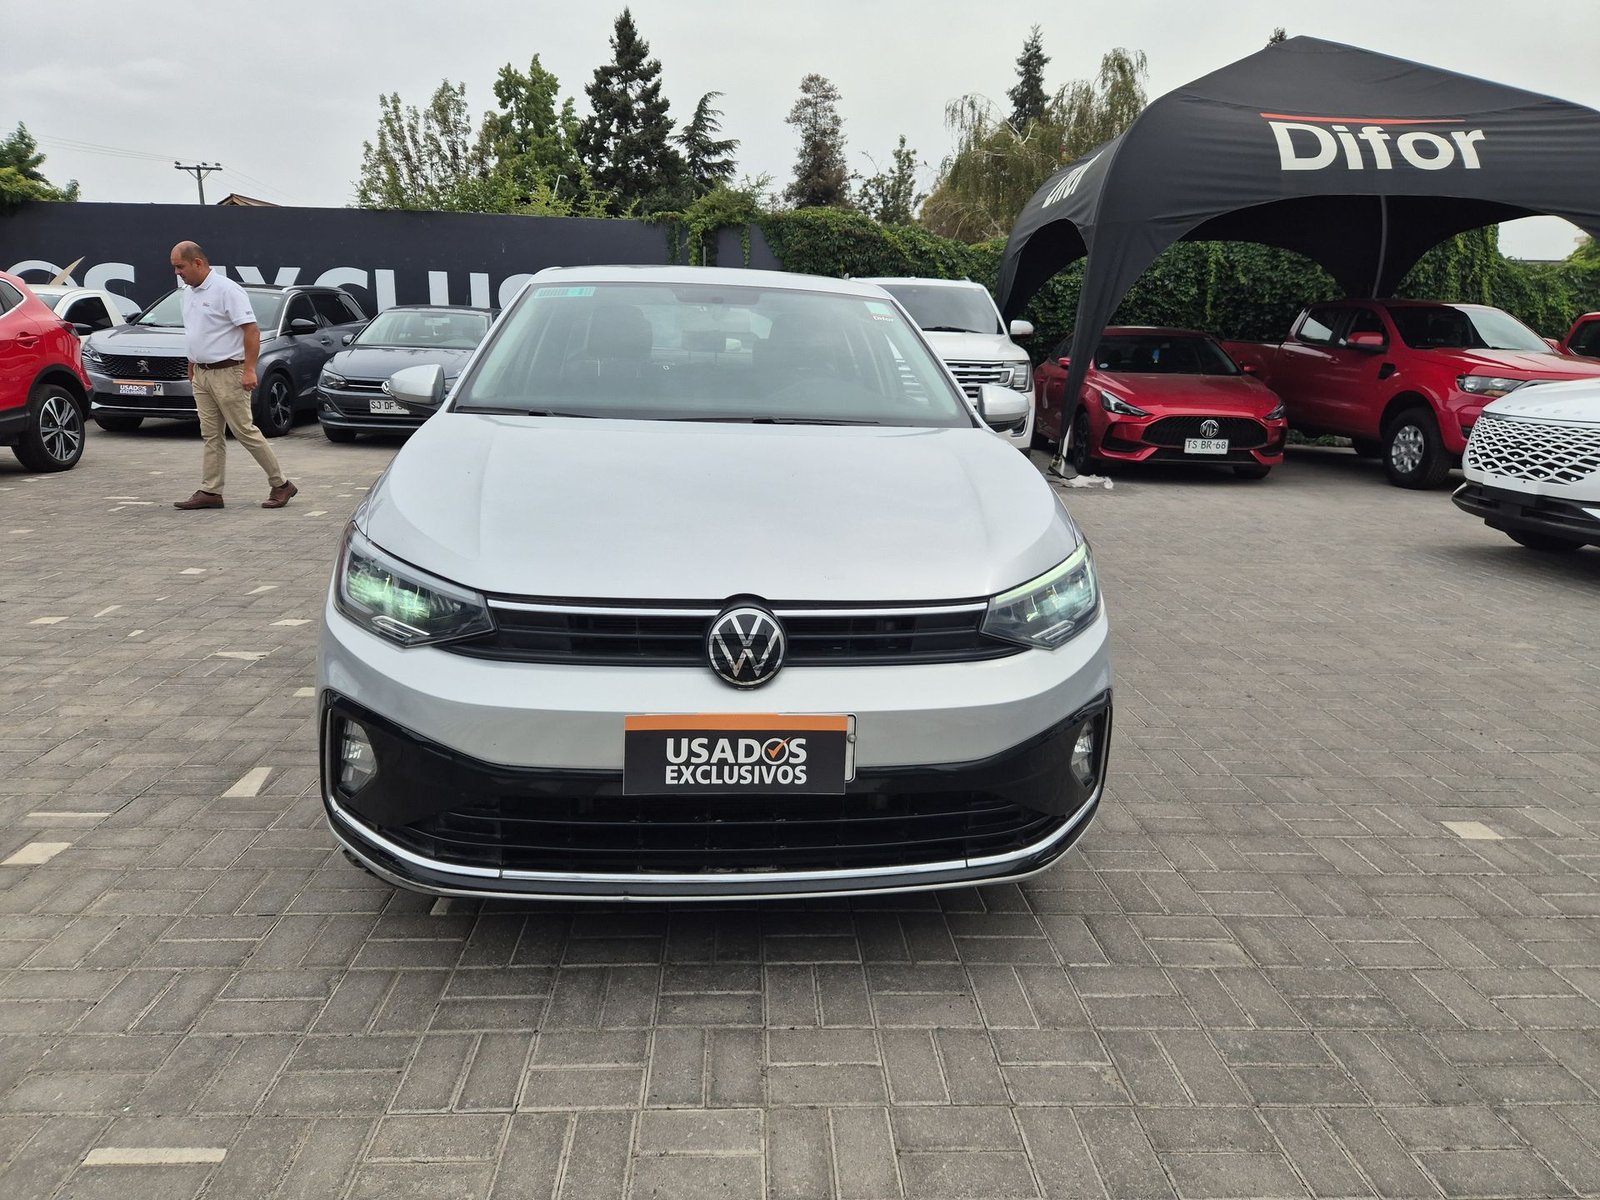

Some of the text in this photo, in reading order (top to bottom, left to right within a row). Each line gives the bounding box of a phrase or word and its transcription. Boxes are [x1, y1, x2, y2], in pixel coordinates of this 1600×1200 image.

[1268, 121, 1486, 170] Difor
[1187, 440, 1198, 449] TS
[666, 737, 807, 765] USADOS
[665, 765, 807, 785] EXCLUSIVOS
